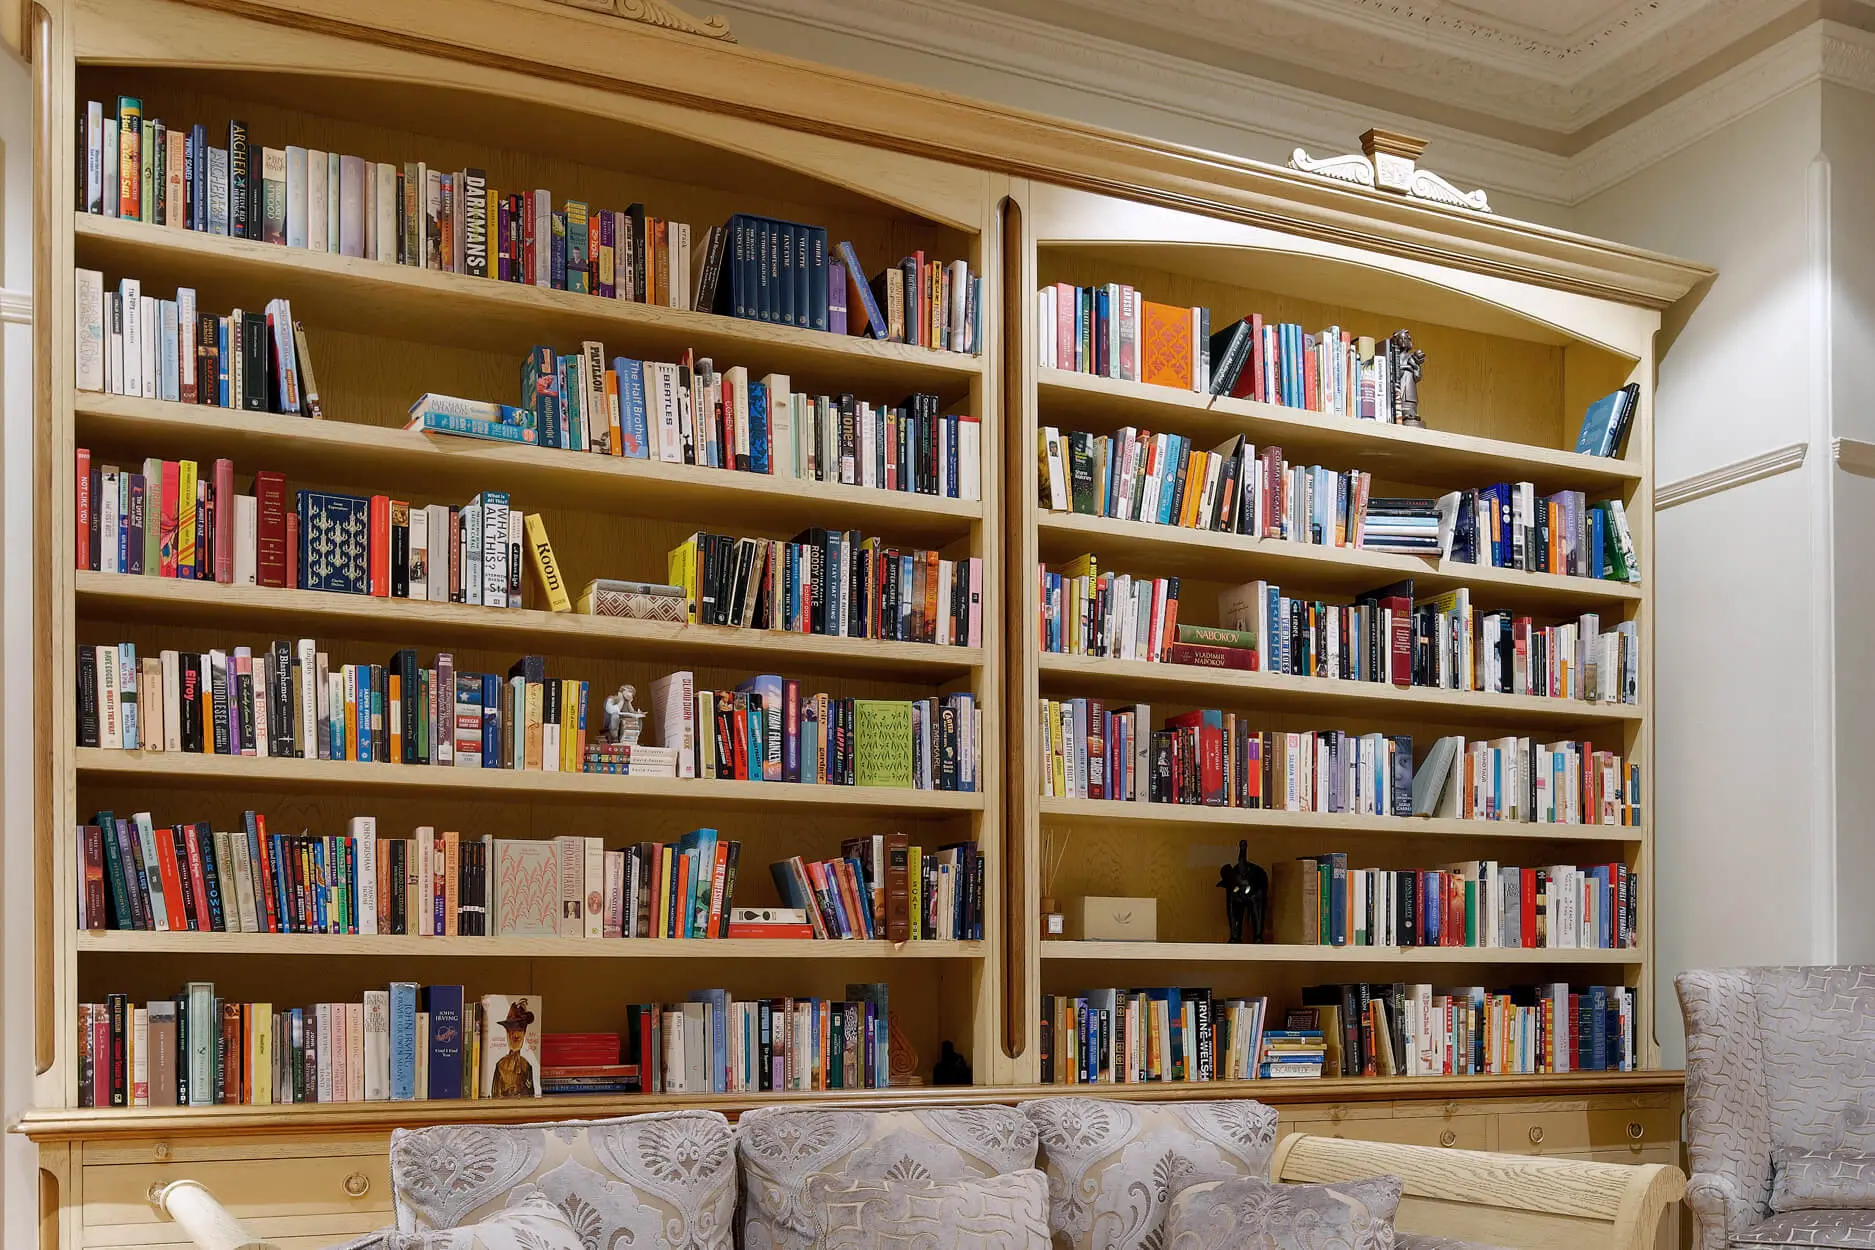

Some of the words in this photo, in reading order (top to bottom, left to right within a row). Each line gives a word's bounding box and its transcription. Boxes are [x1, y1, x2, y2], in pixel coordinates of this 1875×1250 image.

[120, 116, 131, 134] Half
[122, 149, 131, 178] Yellow
[233, 125, 245, 175] ARCHER
[122, 179, 130, 198] Sun
[467, 176, 485, 267] DARKMANS
[1123, 287, 1132, 317] LARSSON
[590, 346, 603, 392] PAPILLON
[631, 362, 639, 379] The
[633, 383, 642, 404] Half
[664, 374, 672, 425] BEATLES
[634, 407, 643, 445] Brother
[80, 476, 88, 491] NOT
[80, 509, 88, 524] YOU
[486, 507, 495, 528] ALL
[497, 508, 507, 545] WHAT
[486, 534, 496, 570] THIS?
[497, 551, 506, 562] IS
[536, 543, 560, 591] Room
[811, 546, 819, 576] RODDY
[811, 578, 819, 607] DOYLE
[1196, 630, 1240, 644] NABOKOV
[1194, 658, 1225, 667] NABOKOV
[184, 670, 196, 701] Ellroy
[277, 655, 289, 702] Blasphemer
[214, 680, 226, 724] MIDDLESEX
[1092, 703, 1101, 733] MATTHEW
[769, 732, 781, 765] FRANZEN
[838, 752, 844, 760] AS
[1093, 735, 1102, 754] REILLY
[125, 855, 133, 874] PETER
[363, 841, 372, 871] GRISHAM
[563, 840, 574, 872] THOMAS
[716, 864, 726, 874] THE
[563, 874, 574, 899] HARDY
[712, 876, 724, 915] PROFESSIONAL
[404, 1003, 413, 1031] JOHN
[1199, 1001, 1207, 1039] IRVINE
[404, 1033, 414, 1068] IRVING
[1200, 1042, 1209, 1081] WELSH
